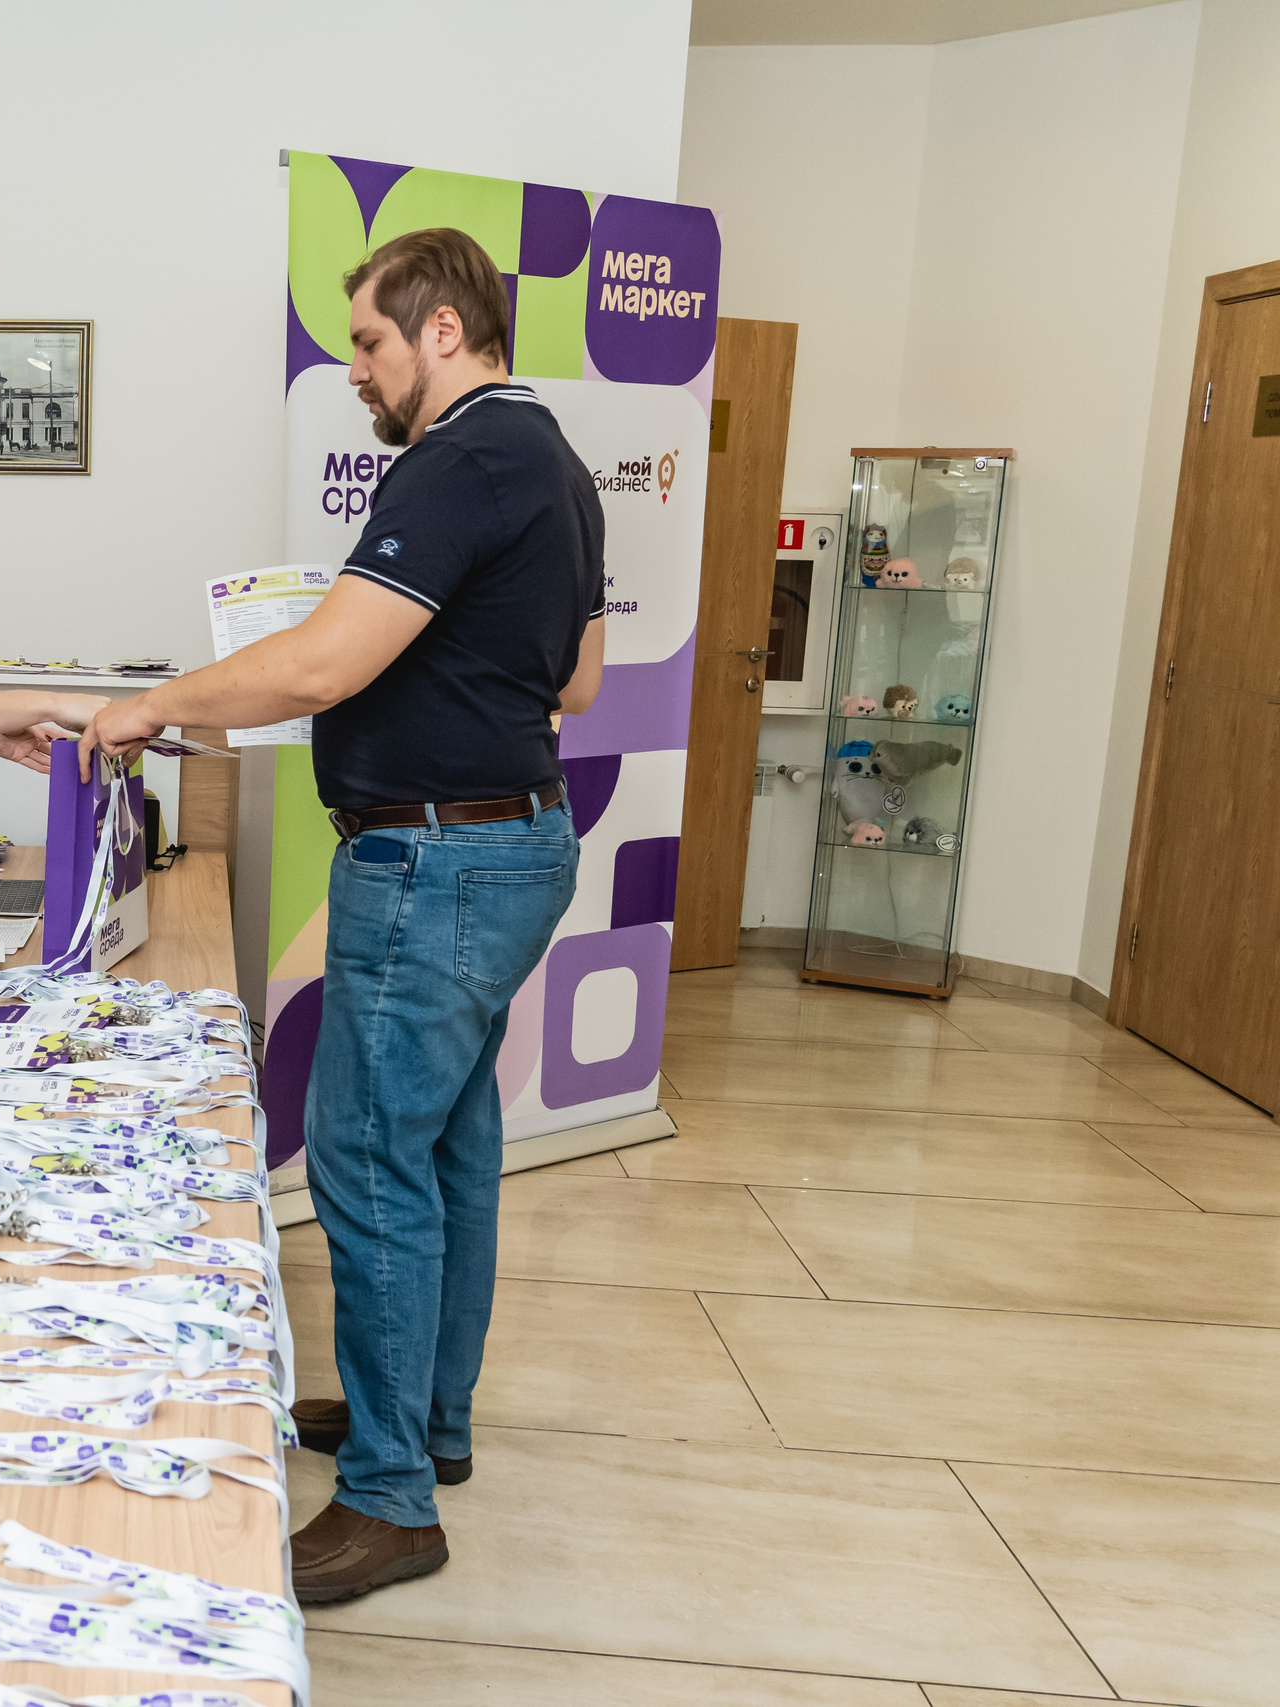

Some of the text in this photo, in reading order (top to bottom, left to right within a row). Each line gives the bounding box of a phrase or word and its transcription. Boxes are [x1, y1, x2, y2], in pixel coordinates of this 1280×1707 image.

[602, 250, 671, 284] мега
[600, 283, 706, 321] маркет
[323, 453, 400, 483] мег
[618, 456, 652, 476] мой
[304, 577, 330, 585] среда
[100, 917, 120, 941] мега
[100, 928, 124, 956] среда
